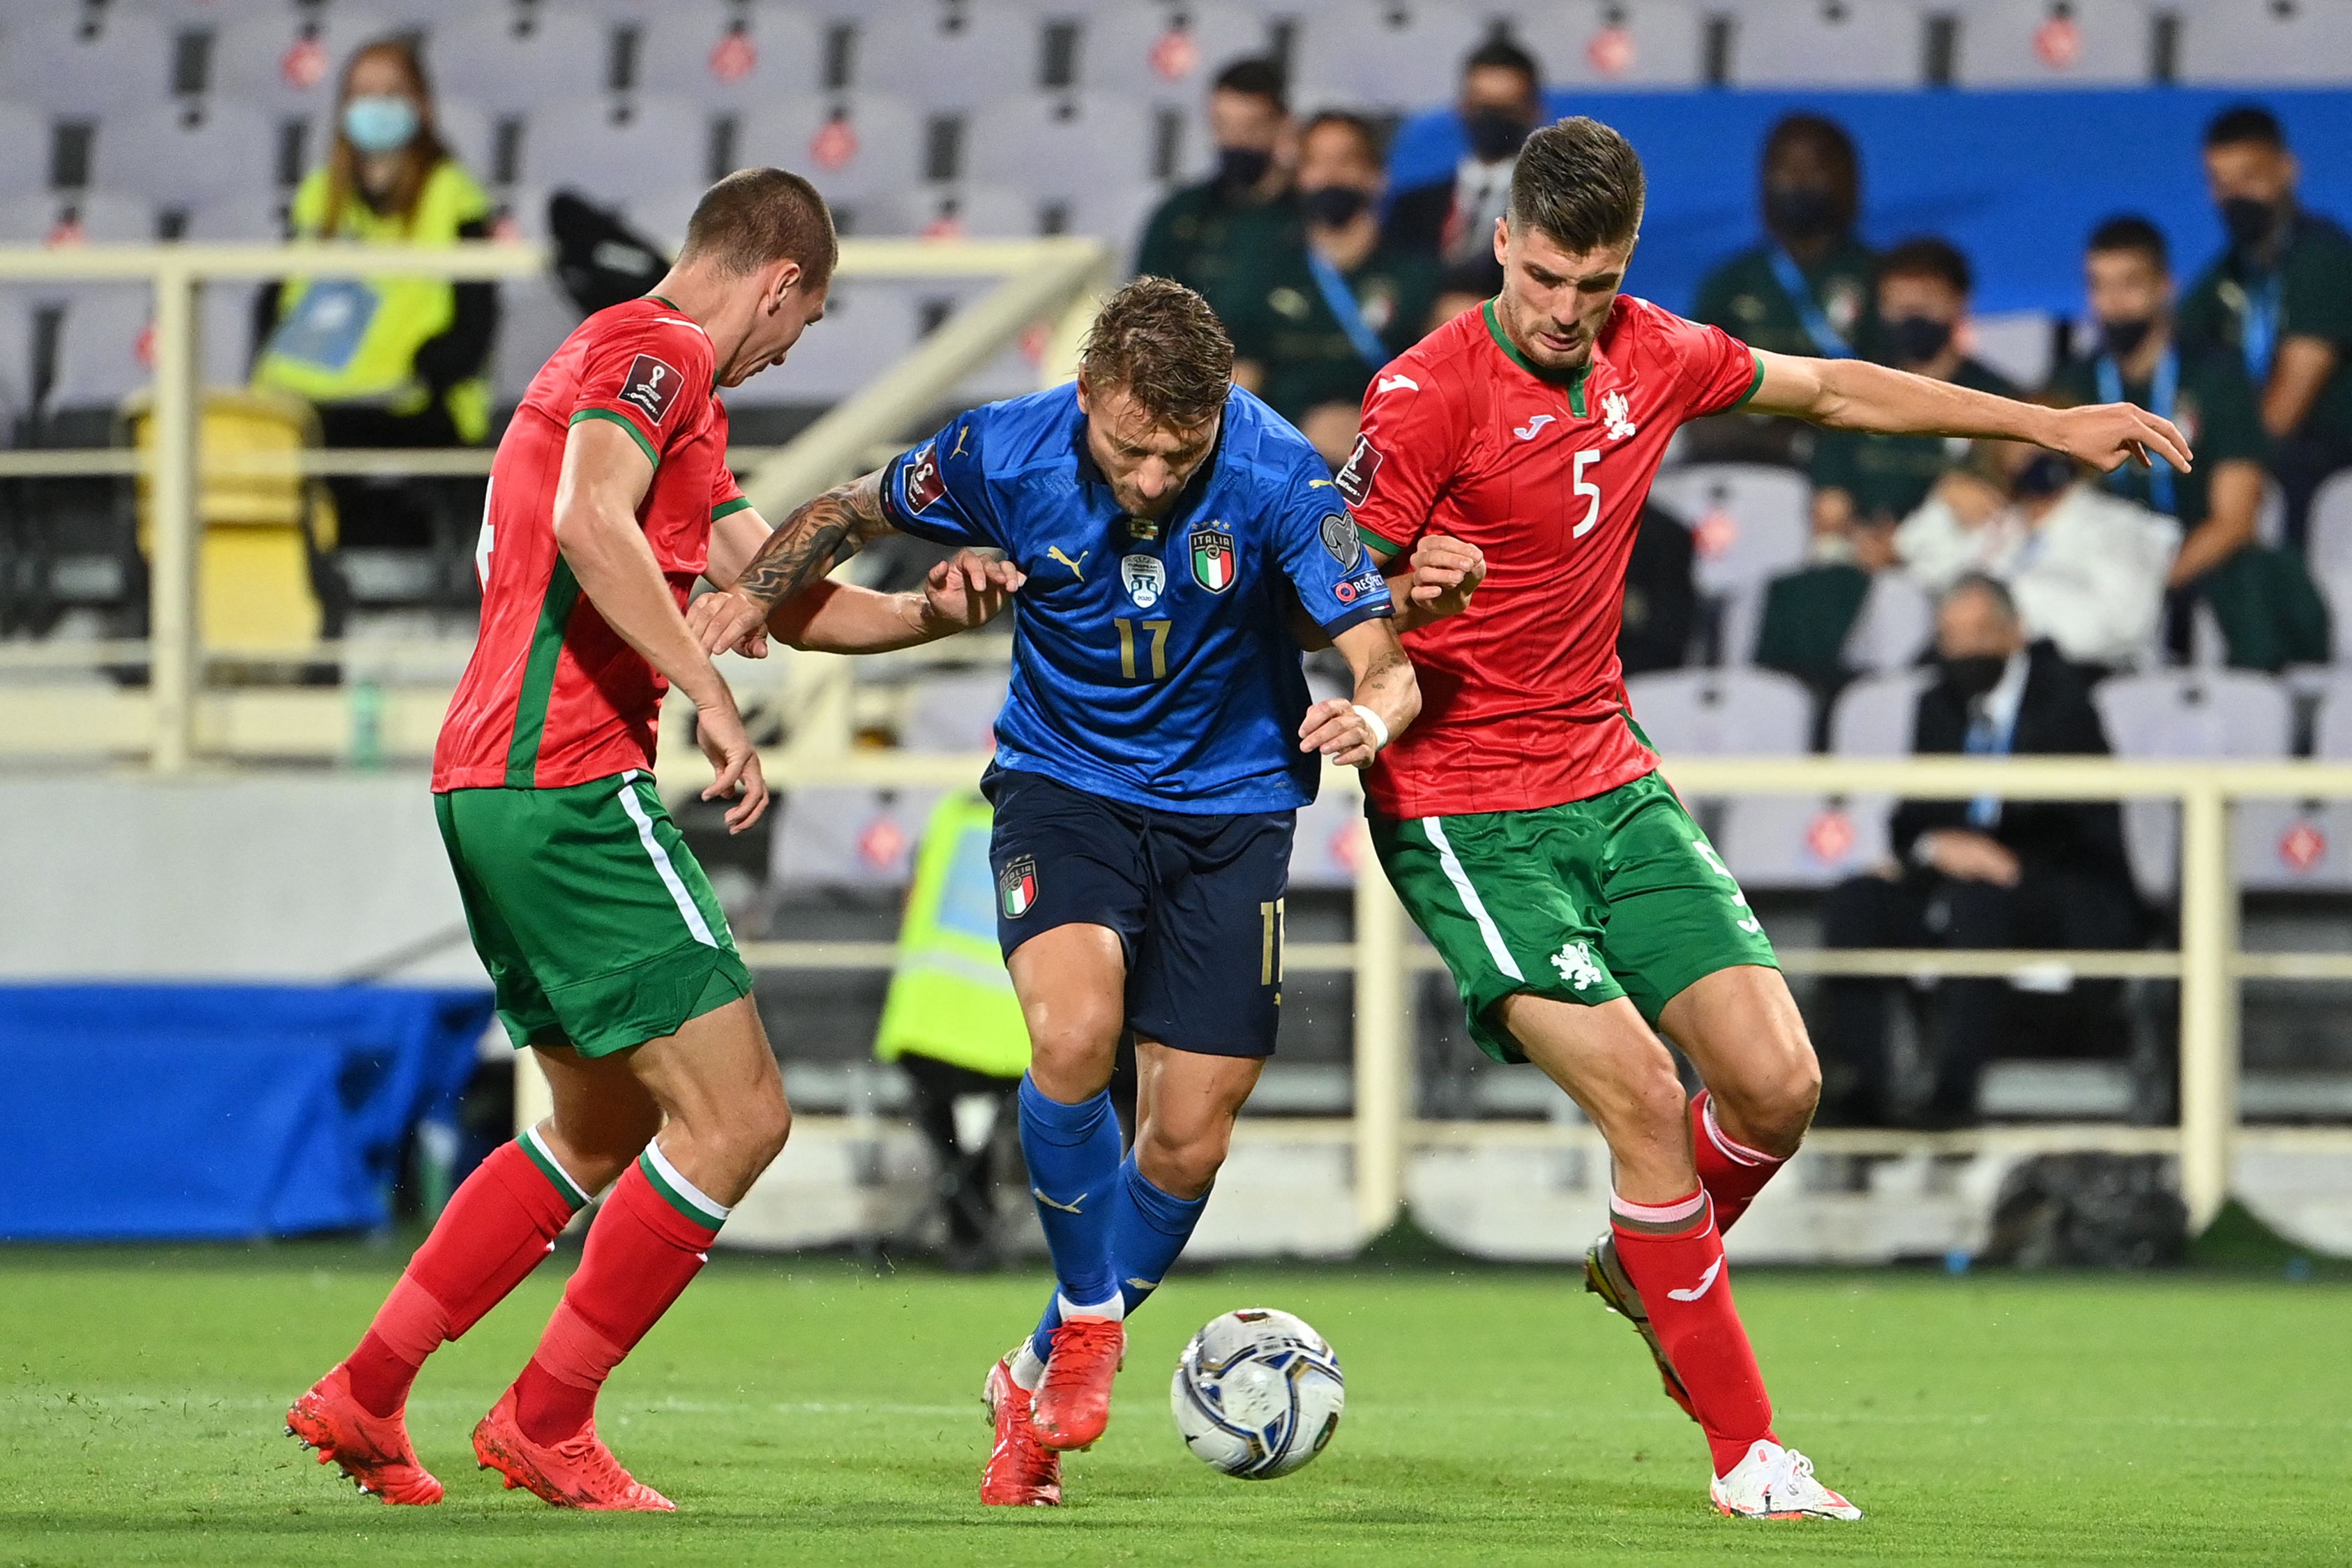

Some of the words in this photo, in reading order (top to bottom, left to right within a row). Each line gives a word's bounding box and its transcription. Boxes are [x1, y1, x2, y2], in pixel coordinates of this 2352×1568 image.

[1573, 448, 1601, 539] 5
[1193, 534, 1230, 546] ITALIA
[1353, 574, 1385, 593] RESPECT
[1114, 618, 1172, 679] 17
[1002, 866, 1032, 889] ITALIA
